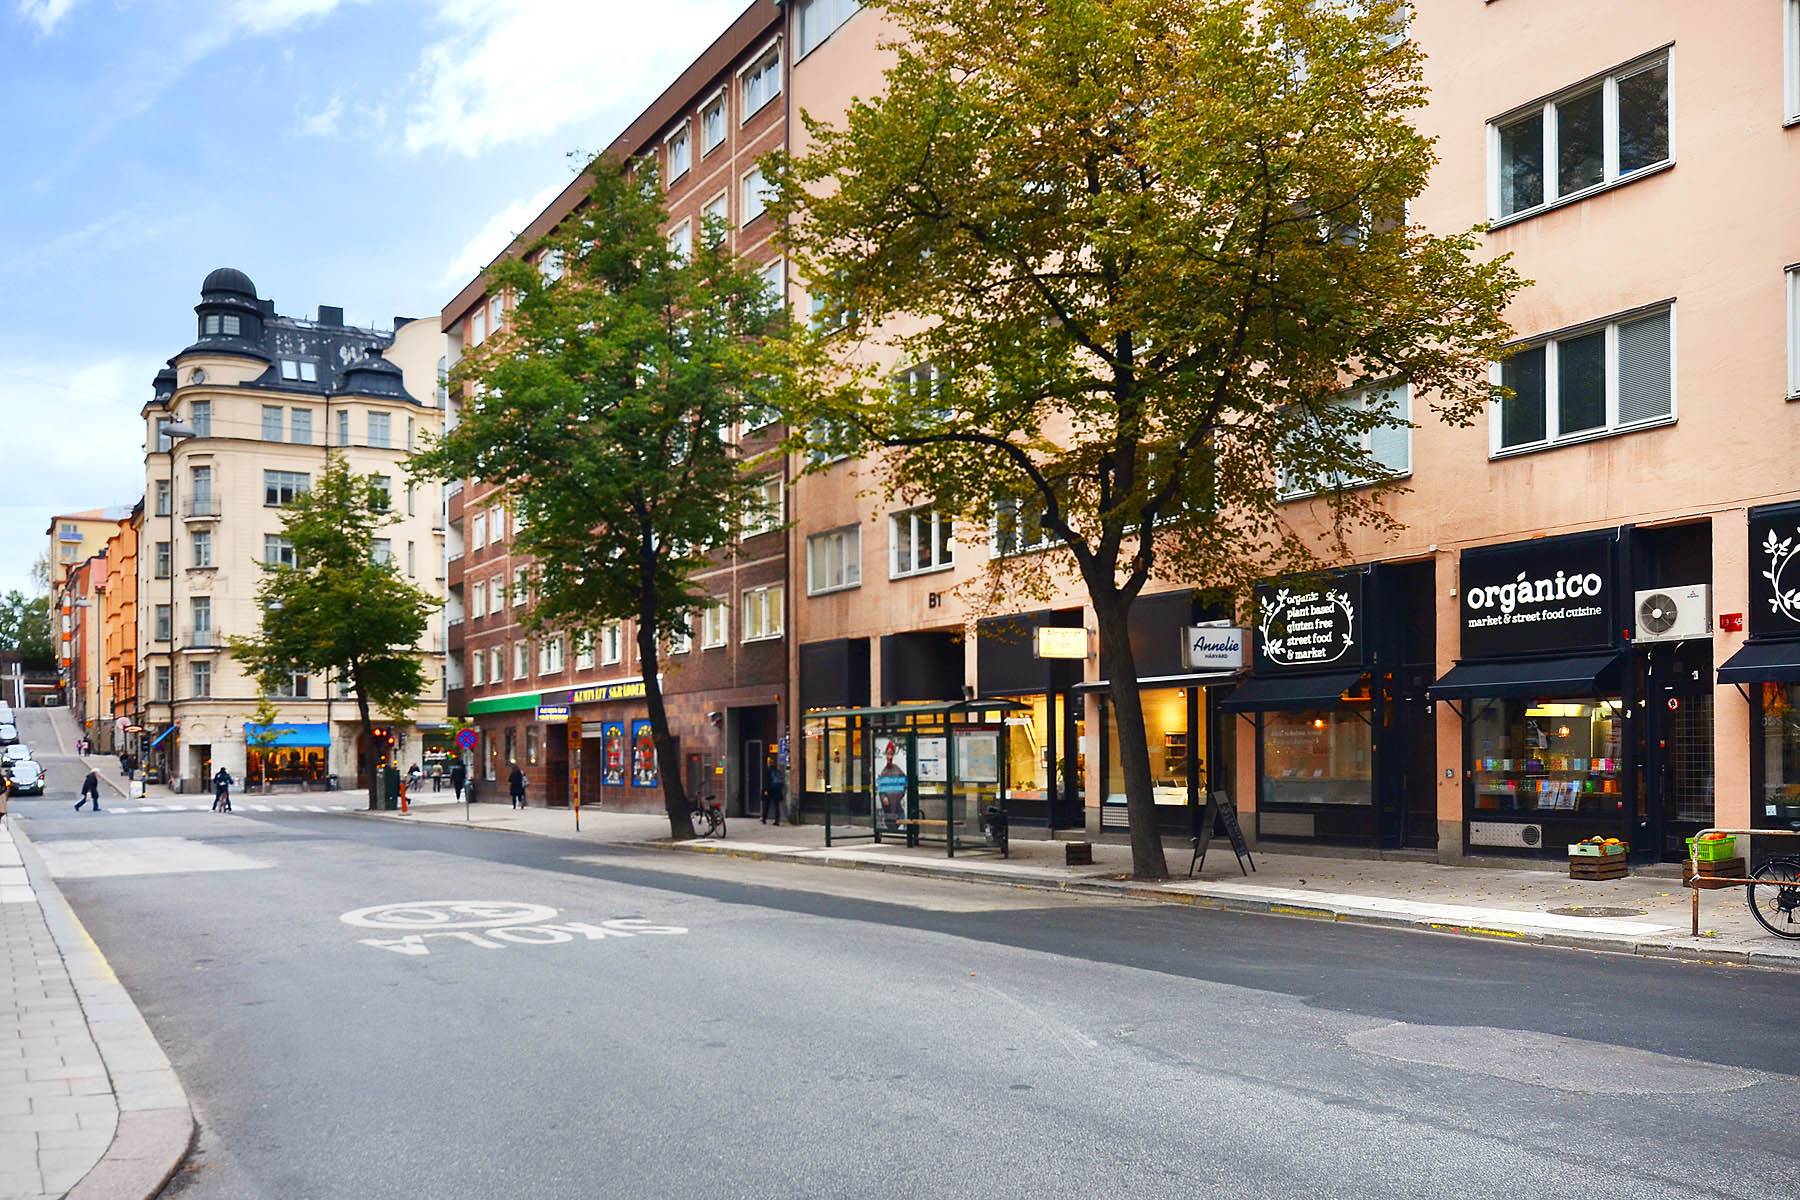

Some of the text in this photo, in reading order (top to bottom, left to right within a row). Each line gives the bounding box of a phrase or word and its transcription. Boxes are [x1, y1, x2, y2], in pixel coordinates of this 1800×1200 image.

[1286, 591, 1319, 606] organic
[1467, 570, 1603, 614] orgánico
[1286, 603, 1335, 621] plant based
[1468, 606, 1602, 628] market & street food cuisine
[1286, 618, 1334, 633] gluten free
[1193, 635, 1240, 652] Annelie
[1286, 631, 1333, 646] street food
[1286, 647, 1327, 660] & market
[357, 918, 689, 956] SKOLA
